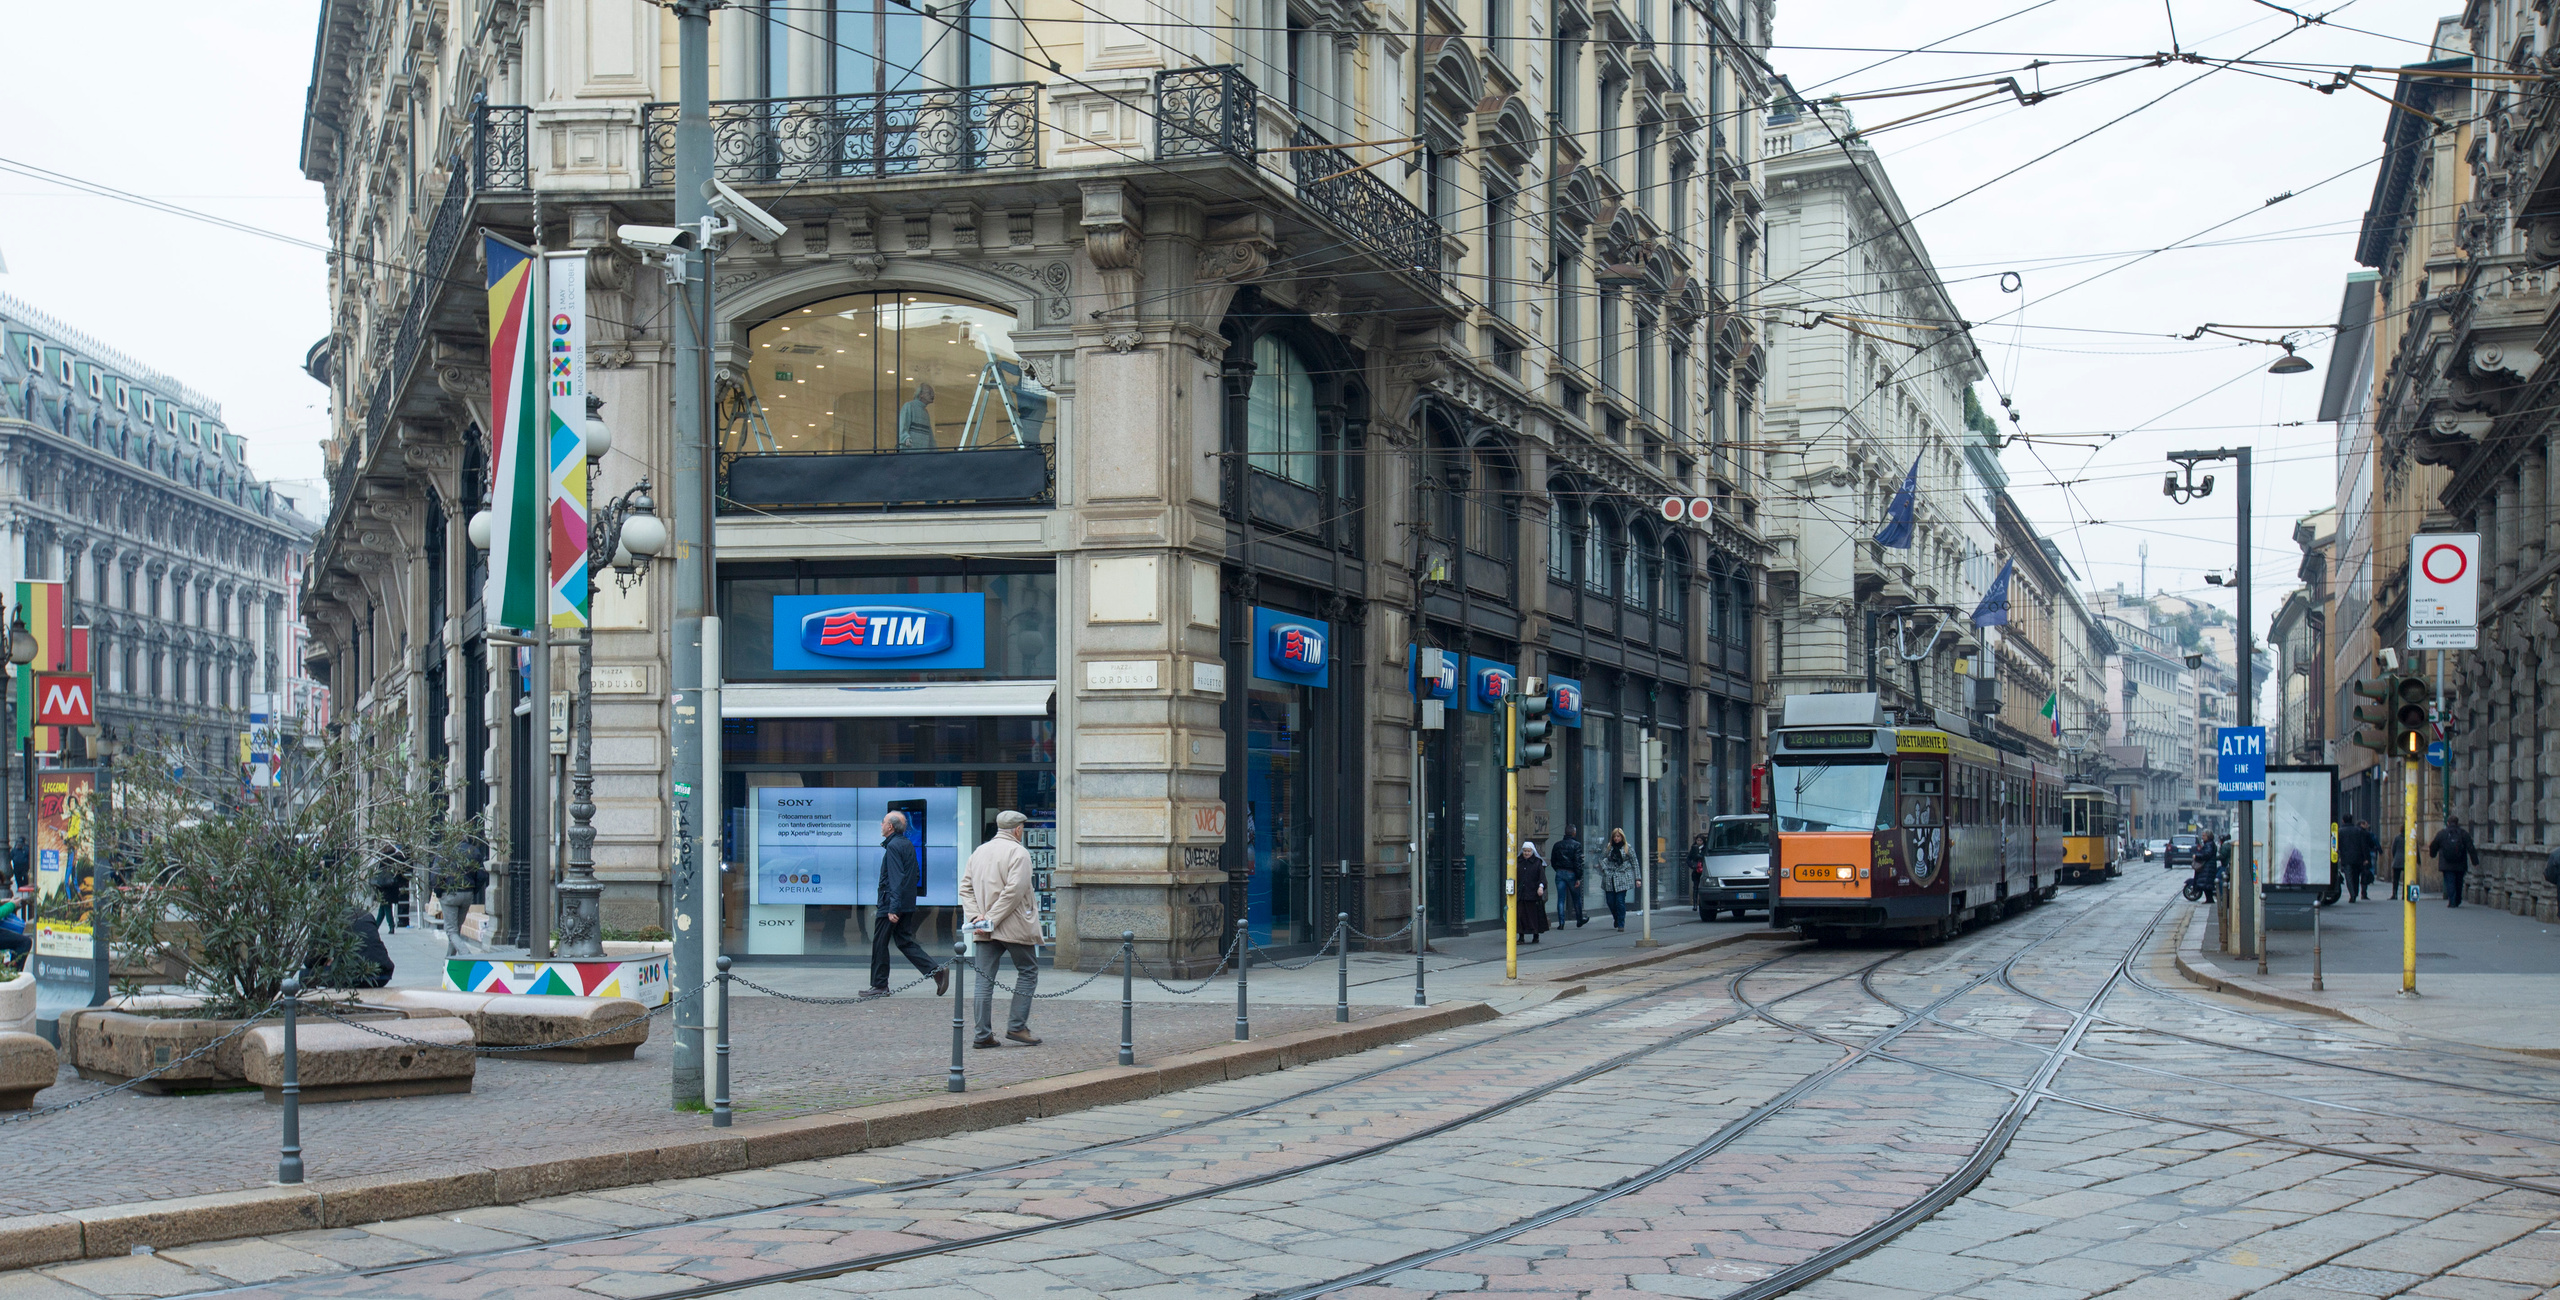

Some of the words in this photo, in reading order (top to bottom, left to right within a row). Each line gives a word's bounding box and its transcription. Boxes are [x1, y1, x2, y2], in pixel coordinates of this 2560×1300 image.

[569, 302, 575, 310] 31
[553, 314, 571, 396] EXPO
[870, 617, 926, 645] TIM
[1303, 636, 1322, 665] TIM
[591, 680, 643, 689] ORDUSIO
[1091, 675, 1154, 684] CORDUSIO
[42, 684, 90, 716] M
[1569, 693, 1579, 711] TIM
[1790, 735, 1804, 744] 12
[1829, 733, 1870, 744] MOLISE
[1896, 735, 1942, 749] DIRETTAMENTE
[2221, 735, 2262, 756] A.T.M.
[2234, 763, 2249, 774] FINE
[2218, 781, 2265, 792] RALLENTAMENTO
[42, 794, 66, 819] TEX
[778, 799, 814, 807] SONY
[1802, 869, 1830, 877] 4969
[46, 964, 67, 976] Comune
[67, 966, 73, 977] di
[73, 966, 90, 978] Milano
[638, 963, 661, 986] EXPO
